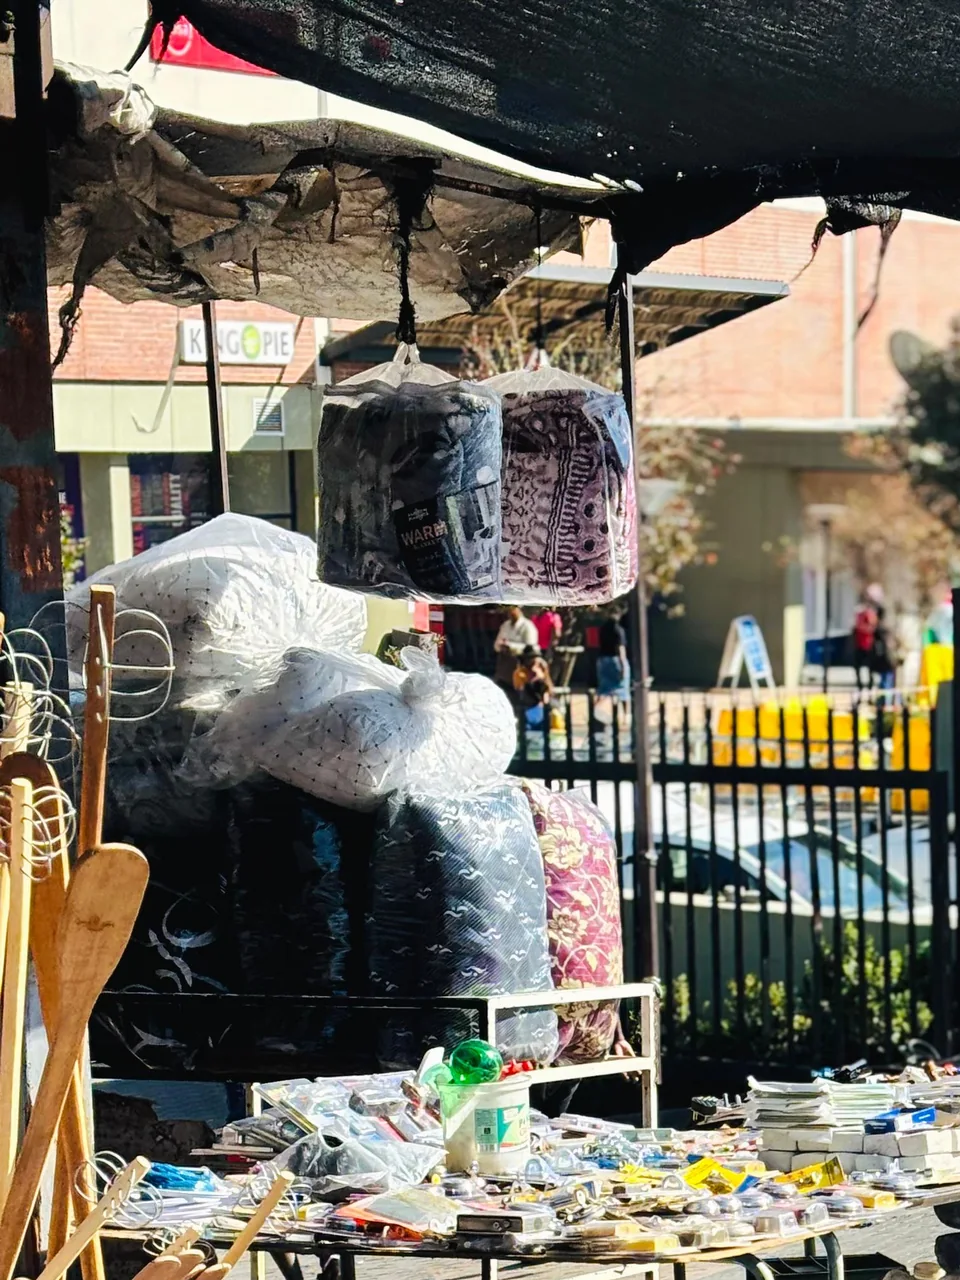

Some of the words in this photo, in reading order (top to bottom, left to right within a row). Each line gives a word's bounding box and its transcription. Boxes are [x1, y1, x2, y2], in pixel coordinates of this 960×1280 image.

[189, 328, 240, 355] KNG
[262, 331, 290, 356] PIE
[401, 520, 448, 546] WARM
